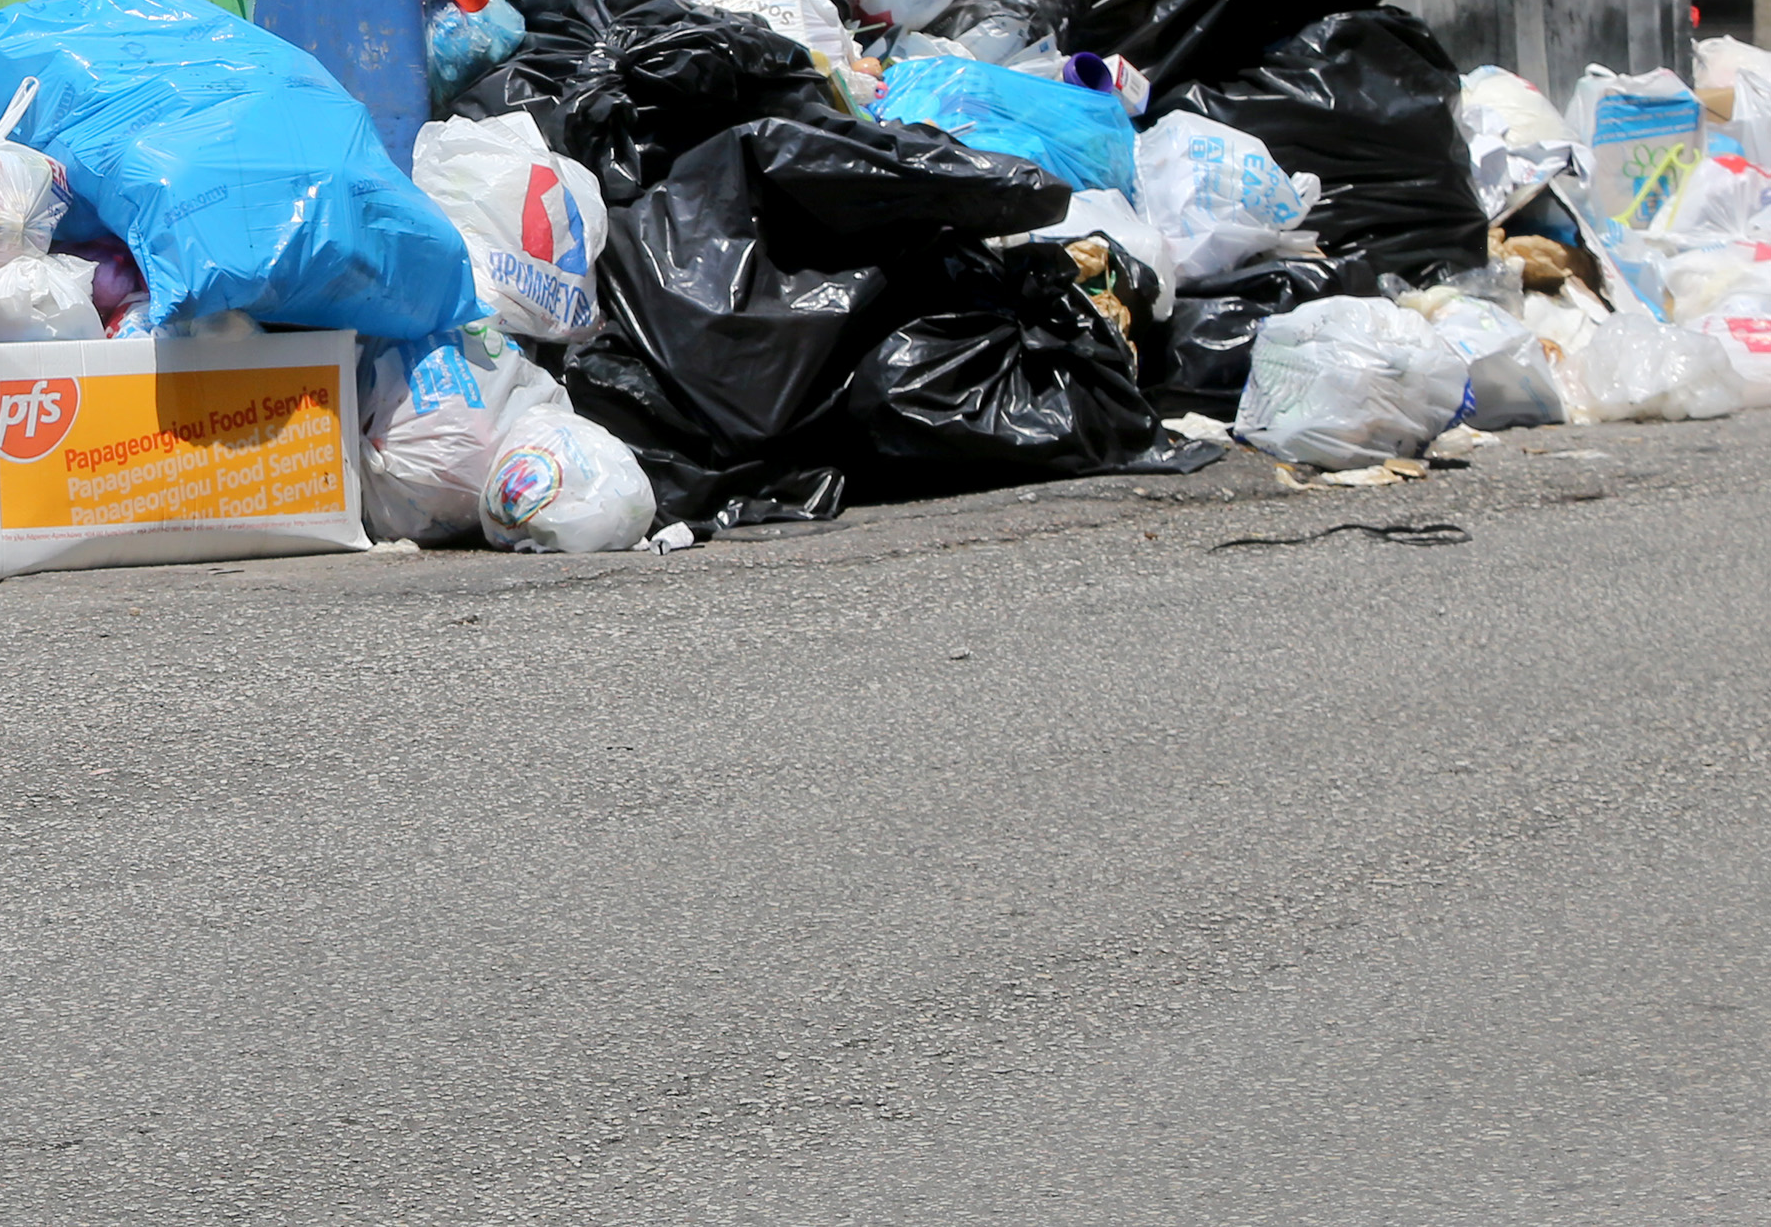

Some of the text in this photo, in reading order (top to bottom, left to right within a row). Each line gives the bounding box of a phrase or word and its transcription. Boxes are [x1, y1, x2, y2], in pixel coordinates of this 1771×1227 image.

[65, 386, 328, 472] Papageorgiou Food Service
[67, 413, 332, 501] Papageorgiou Food Service
[70, 442, 335, 525] Papageorgiou Food Service
[219, 484, 269, 519] Food
[271, 471, 338, 506] Service
